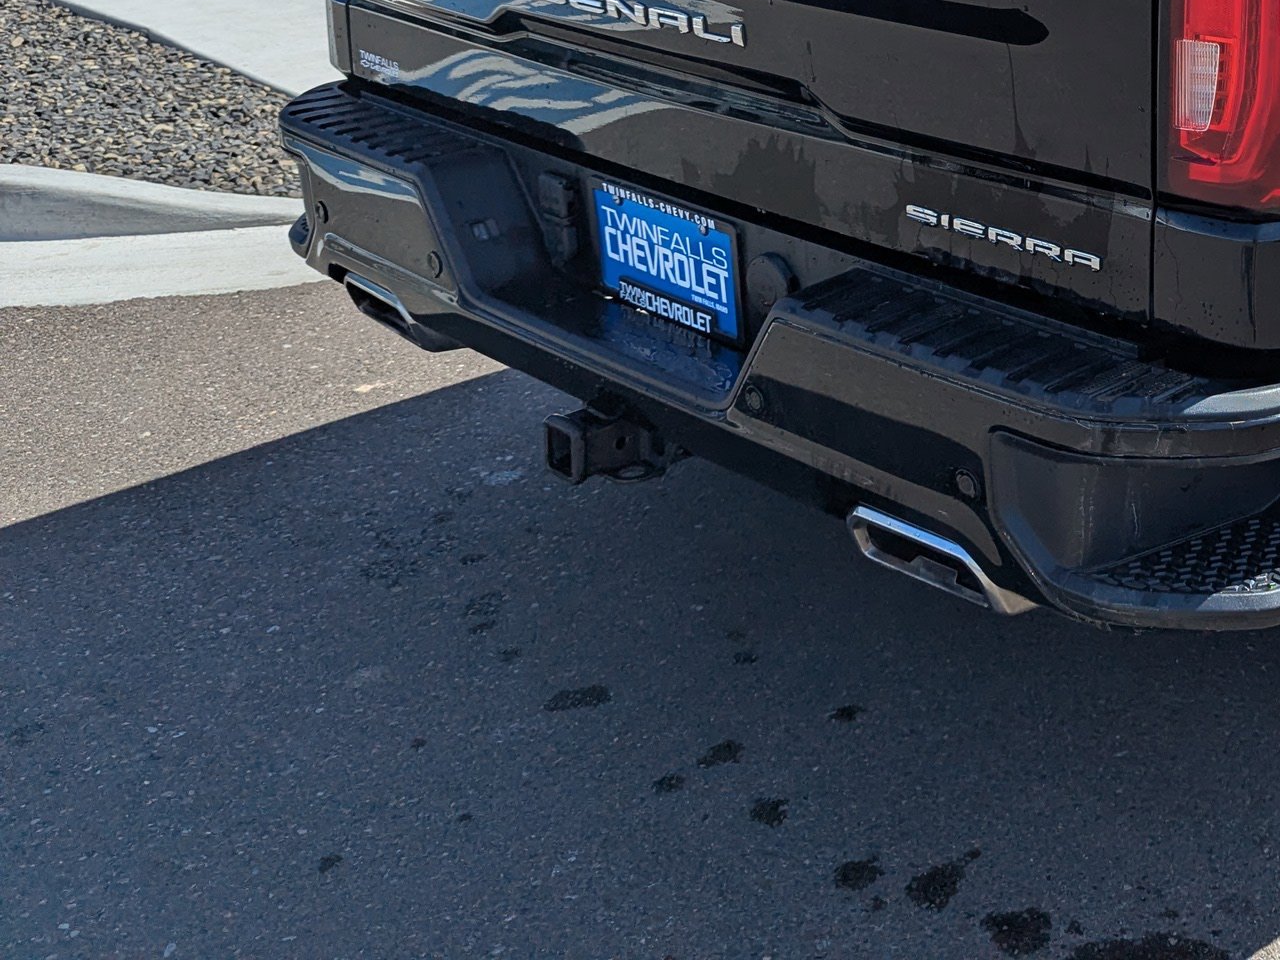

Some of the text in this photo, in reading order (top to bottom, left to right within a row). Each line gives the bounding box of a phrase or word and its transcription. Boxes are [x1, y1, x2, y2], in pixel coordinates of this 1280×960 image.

[601, 182, 716, 230] TWINFALLS-CHEVY.COM
[601, 205, 728, 269] TWINFALLS
[905, 204, 1101, 272] SIERRA
[604, 226, 729, 304] CHEVROLET
[645, 291, 712, 334] CHEVROLET
